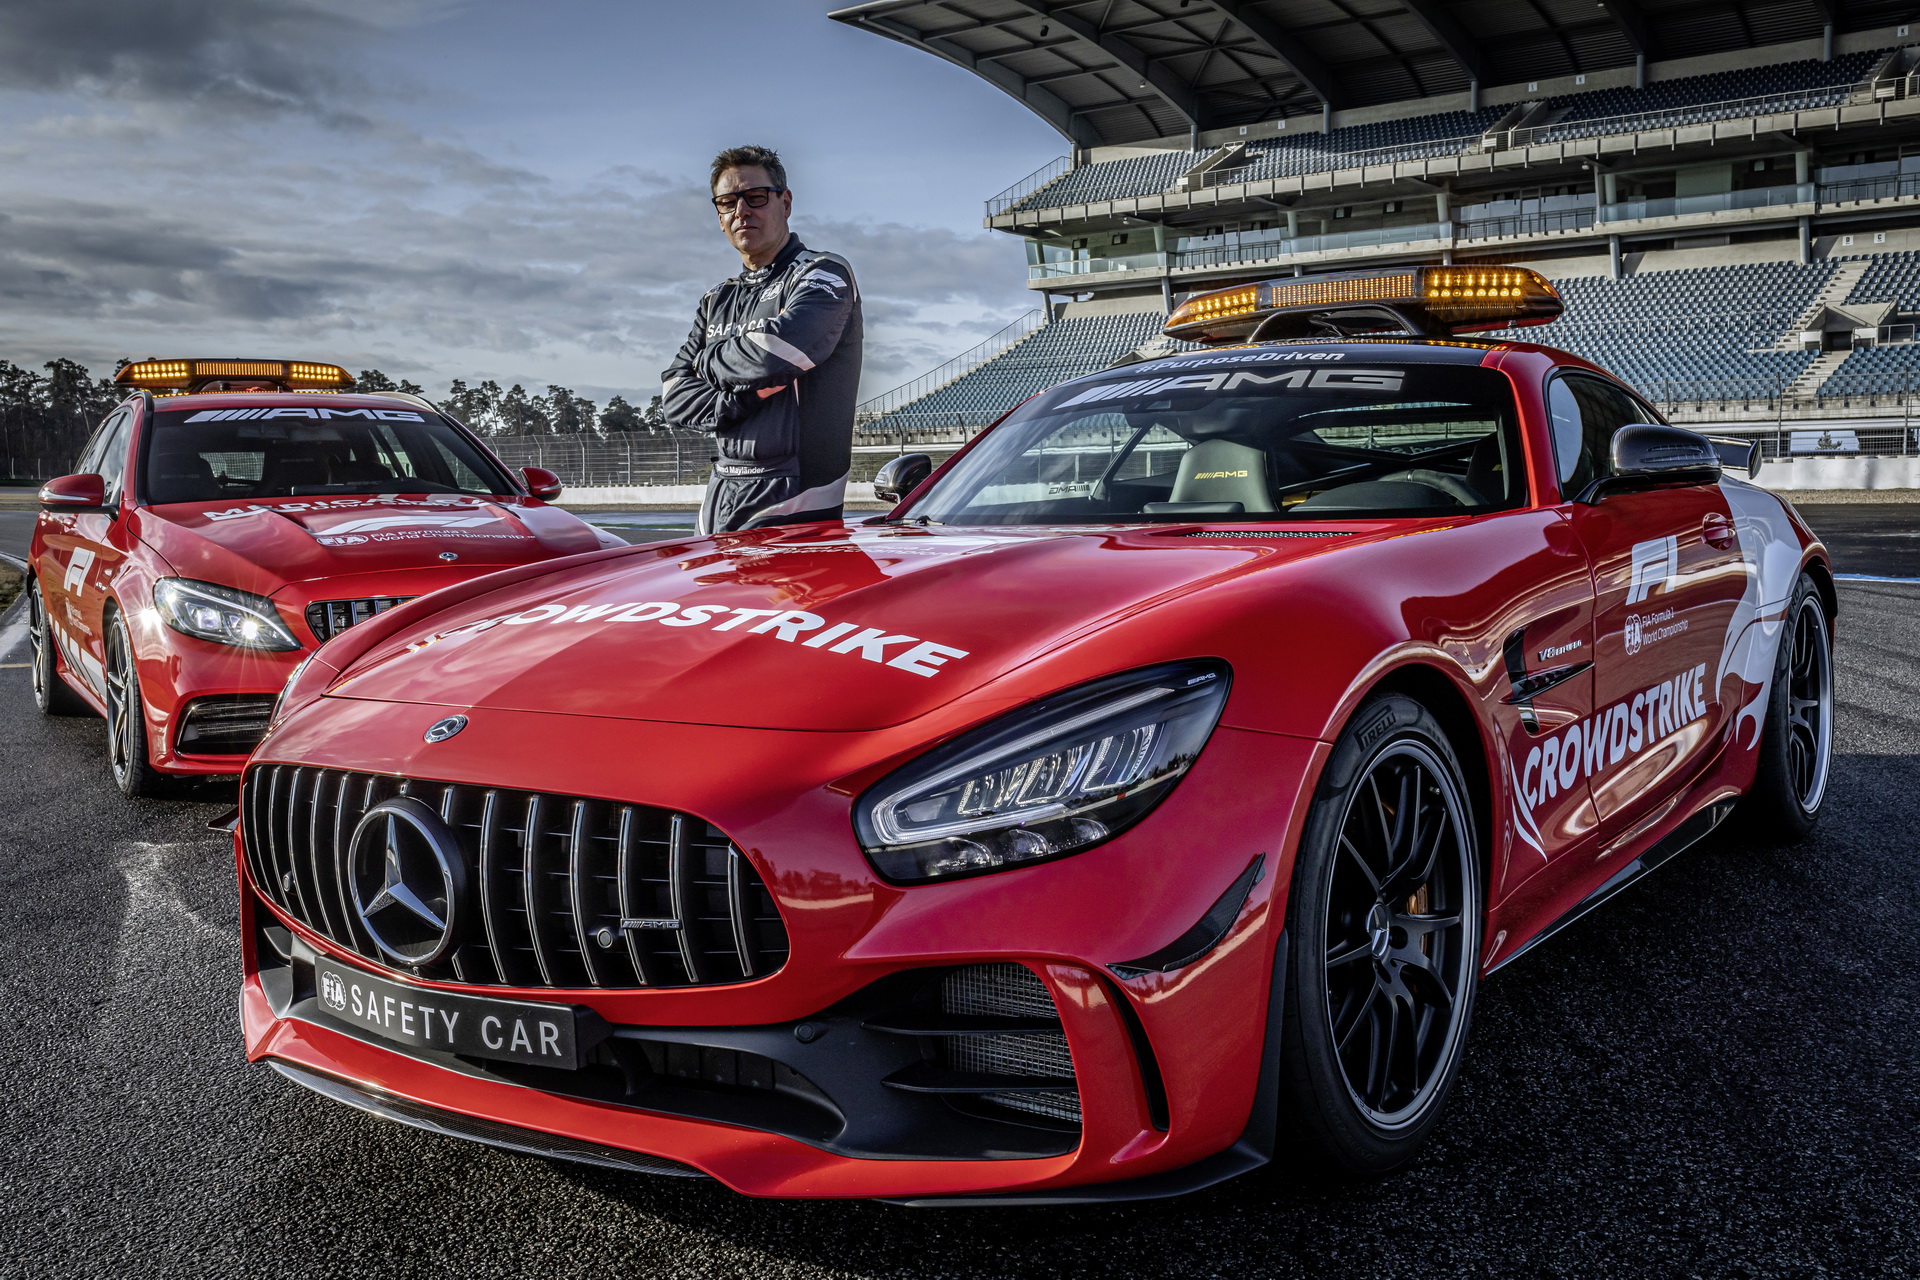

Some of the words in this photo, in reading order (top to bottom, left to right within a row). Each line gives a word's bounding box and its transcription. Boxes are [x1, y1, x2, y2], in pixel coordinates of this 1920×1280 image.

[1135, 352, 1345, 373] #PurposeDriven
[1144, 370, 1405, 395] AMG
[261, 408, 425, 422] AMG
[1212, 470, 1248, 478] AMG
[316, 535, 369, 546] FIA
[1651, 608, 1671, 625] Formula
[1643, 629, 1658, 646] World
[1657, 618, 1689, 640] Championship
[1538, 646, 1555, 661] V8
[1353, 704, 1397, 753] PIRELLI
[1522, 662, 1707, 811] CROWDSTRIKE
[640, 920, 679, 928] AMG
[351, 984, 460, 1044] SAFETY
[481, 1014, 562, 1057] CAR
